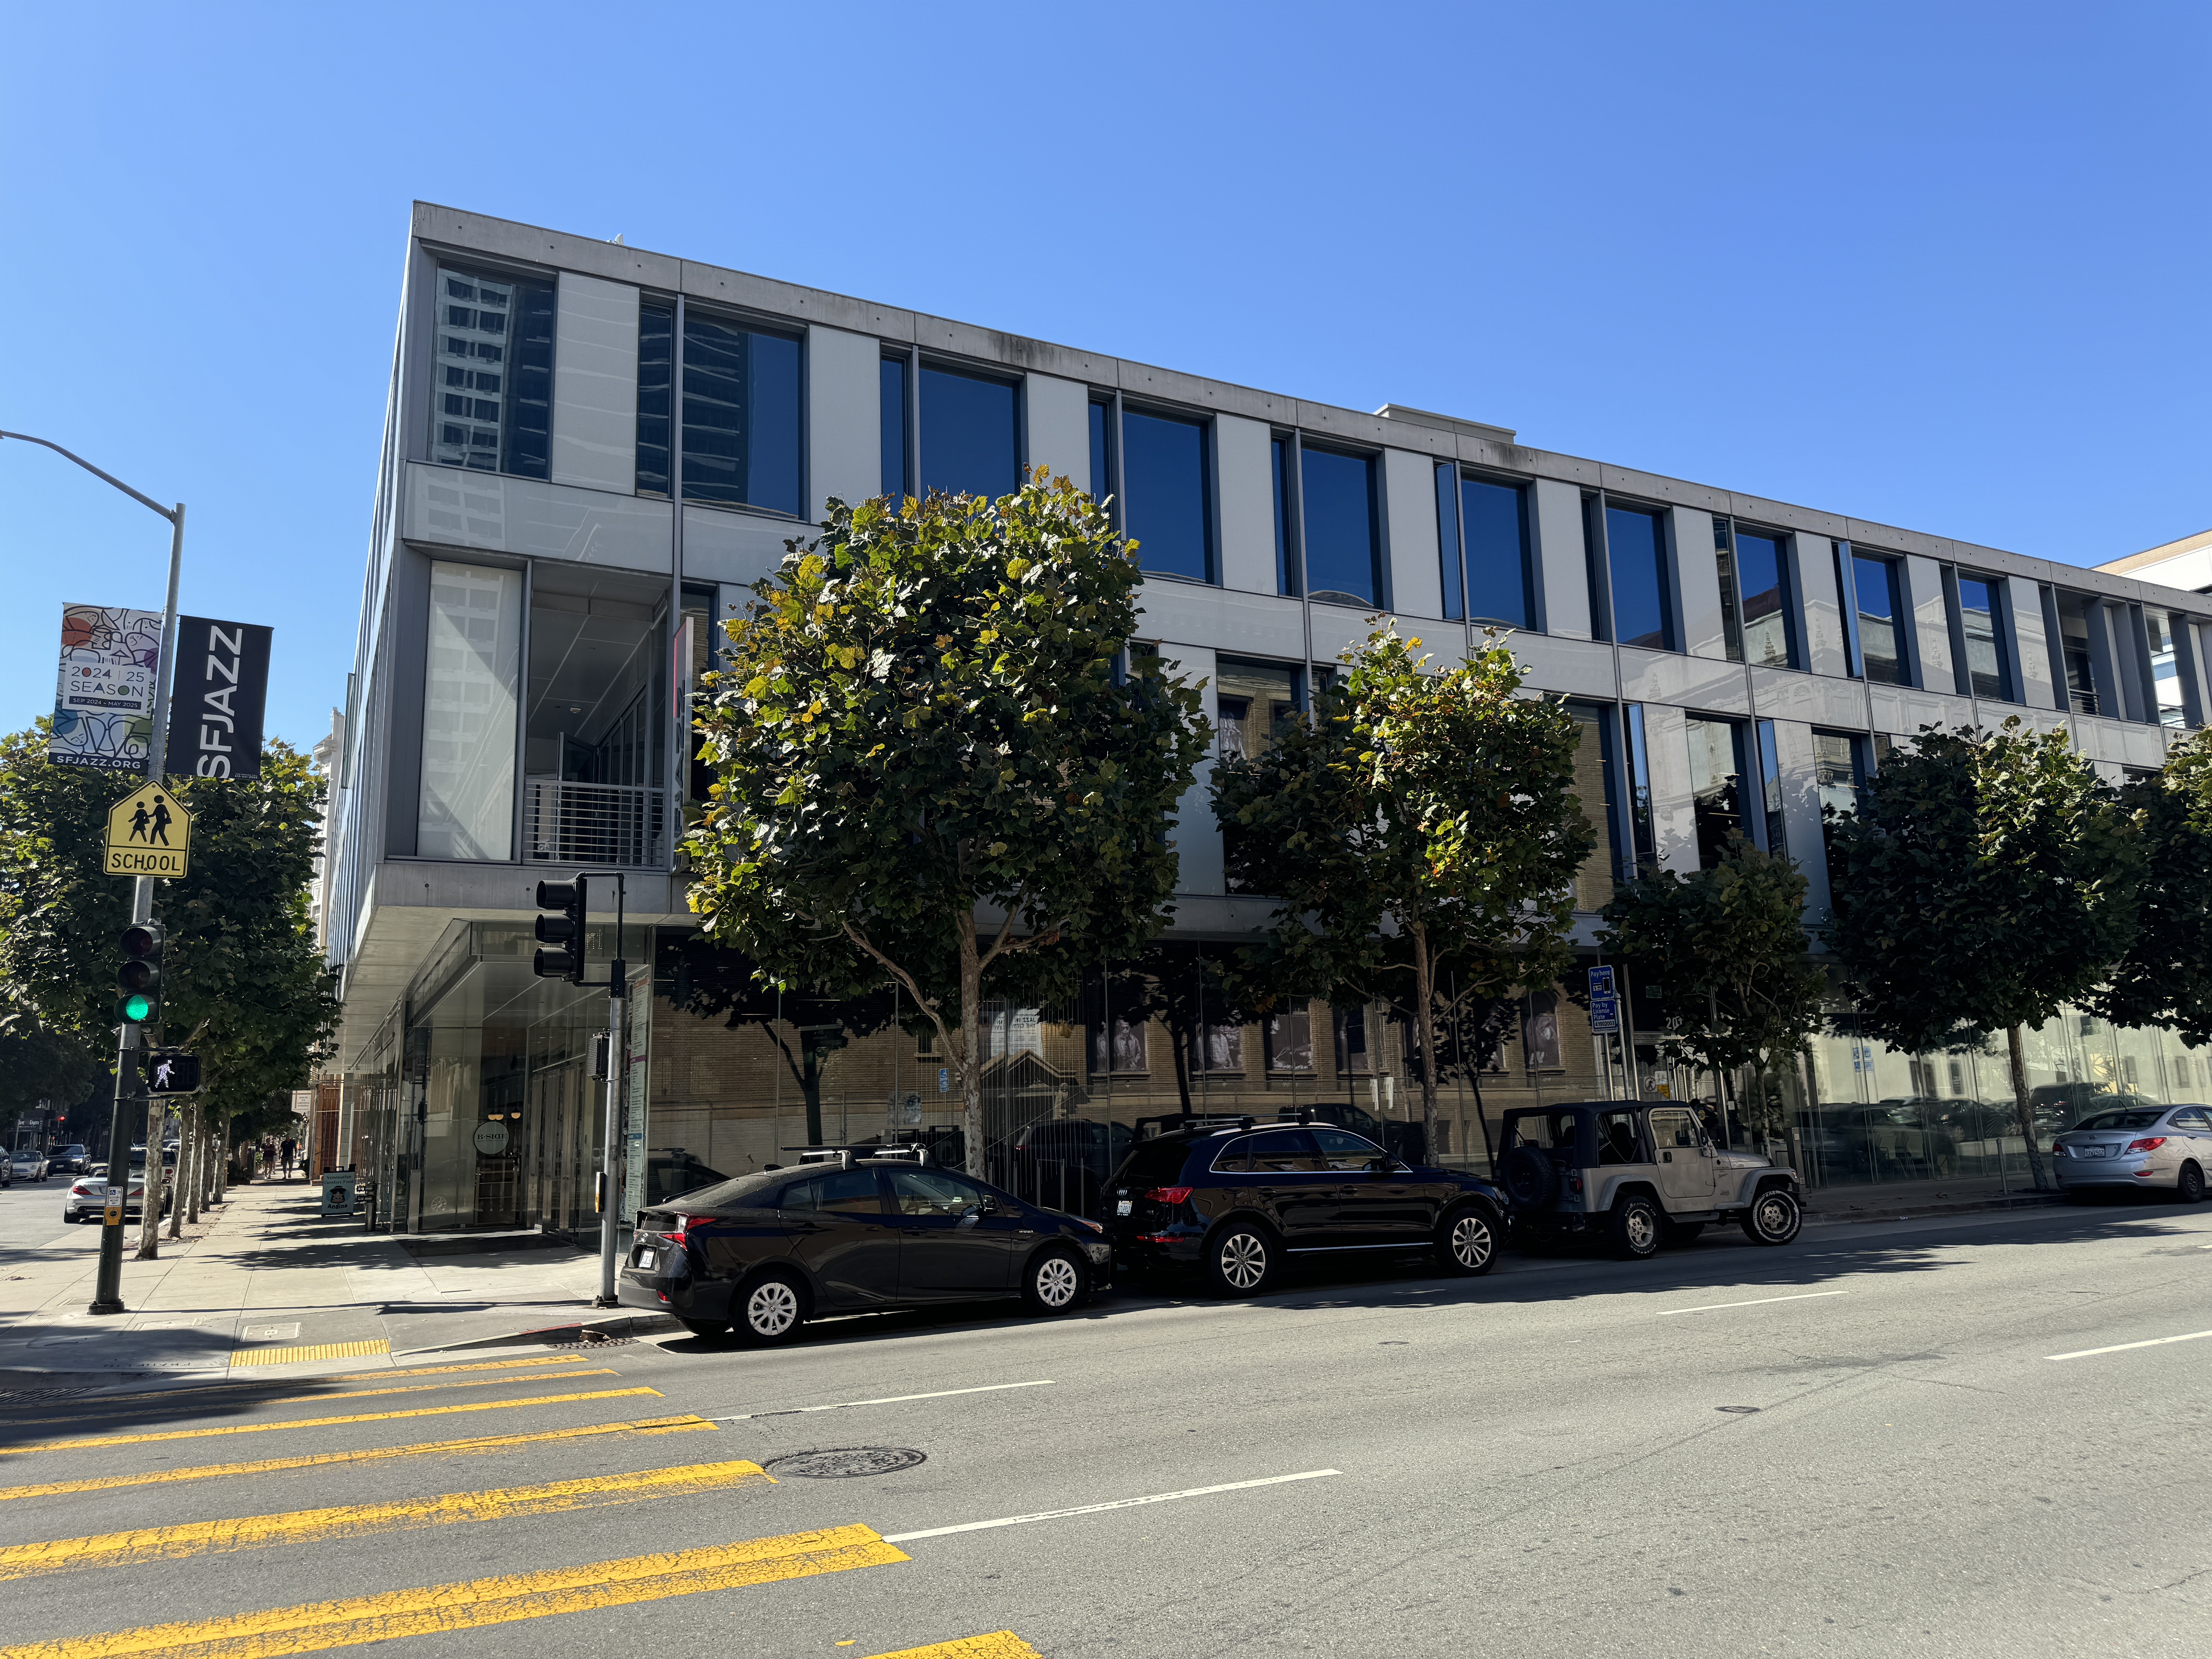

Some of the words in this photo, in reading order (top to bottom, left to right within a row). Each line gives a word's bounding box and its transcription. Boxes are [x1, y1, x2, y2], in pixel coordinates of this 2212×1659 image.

[71, 666, 112, 679] 2024
[127, 672, 144, 682] 25
[70, 681, 143, 697] SEASON
[197, 625, 242, 778] SFJAZZ
[57, 756, 141, 769] SFJAZZ.ORG
[112, 853, 180, 871] SCHOOL
